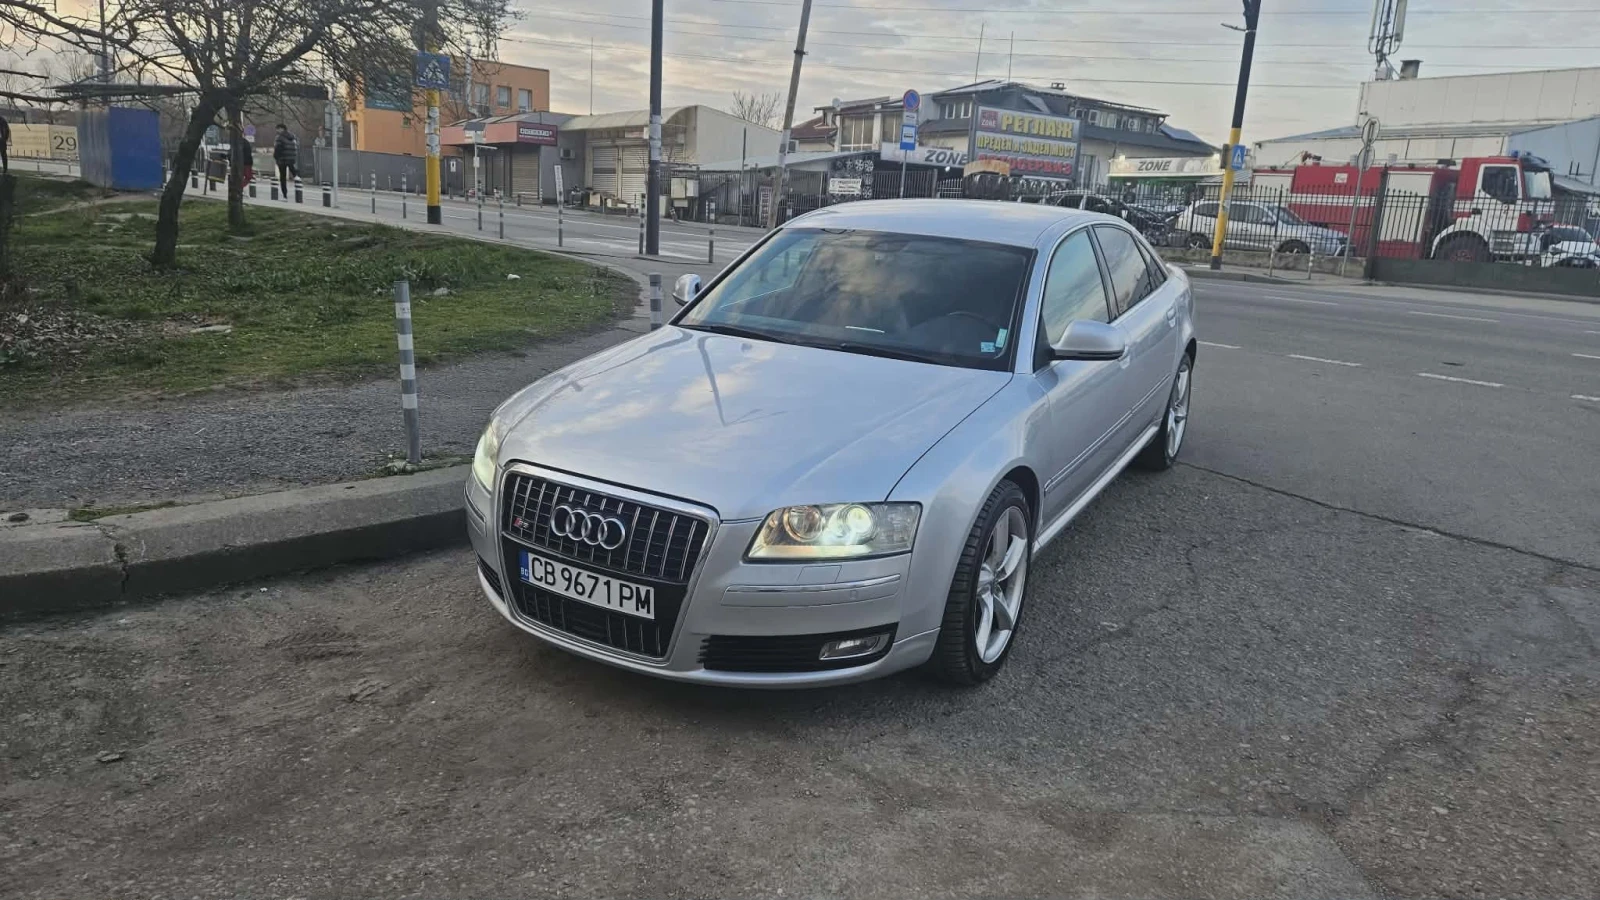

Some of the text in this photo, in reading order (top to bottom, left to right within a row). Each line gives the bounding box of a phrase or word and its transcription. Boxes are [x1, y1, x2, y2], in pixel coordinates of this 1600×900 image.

[1001, 112, 1073, 139] РЕГЛАЖ
[53, 135, 77, 151] 29
[977, 136, 1012, 153] ПРЕДЕН
[1050, 143, 1076, 158] МОСТ
[925, 149, 969, 166] ZONE
[978, 154, 1073, 175] ОСЕРВИЗ
[1137, 160, 1171, 171] ZONE
[531, 557, 556, 586] CB
[561, 567, 611, 604] 9671
[619, 583, 651, 614] PM
